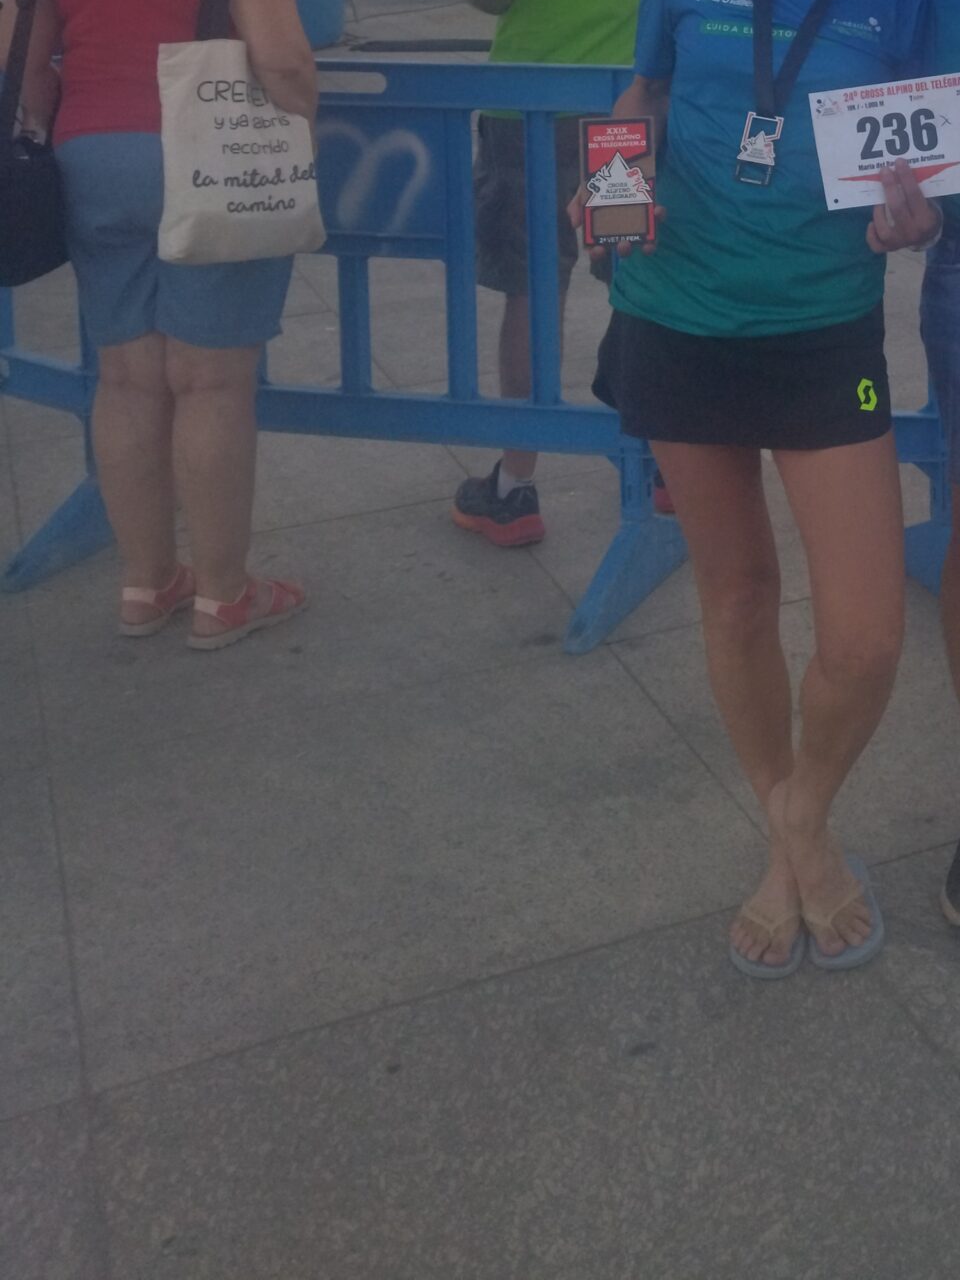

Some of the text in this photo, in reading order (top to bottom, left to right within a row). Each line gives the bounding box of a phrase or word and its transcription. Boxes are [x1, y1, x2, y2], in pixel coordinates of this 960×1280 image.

[706, 22, 738, 33] CUIDA
[860, 86, 885, 100] CROSS
[886, 82, 914, 96] ALPINO
[915, 80, 929, 93] DEL
[214, 116, 224, 130] y
[230, 114, 249, 131] ya
[606, 126, 628, 135] XXIX
[616, 133, 641, 141] ALPINO
[856, 107, 939, 161] 236
[192, 162, 318, 189] la mitad del
[227, 194, 296, 213] camino
